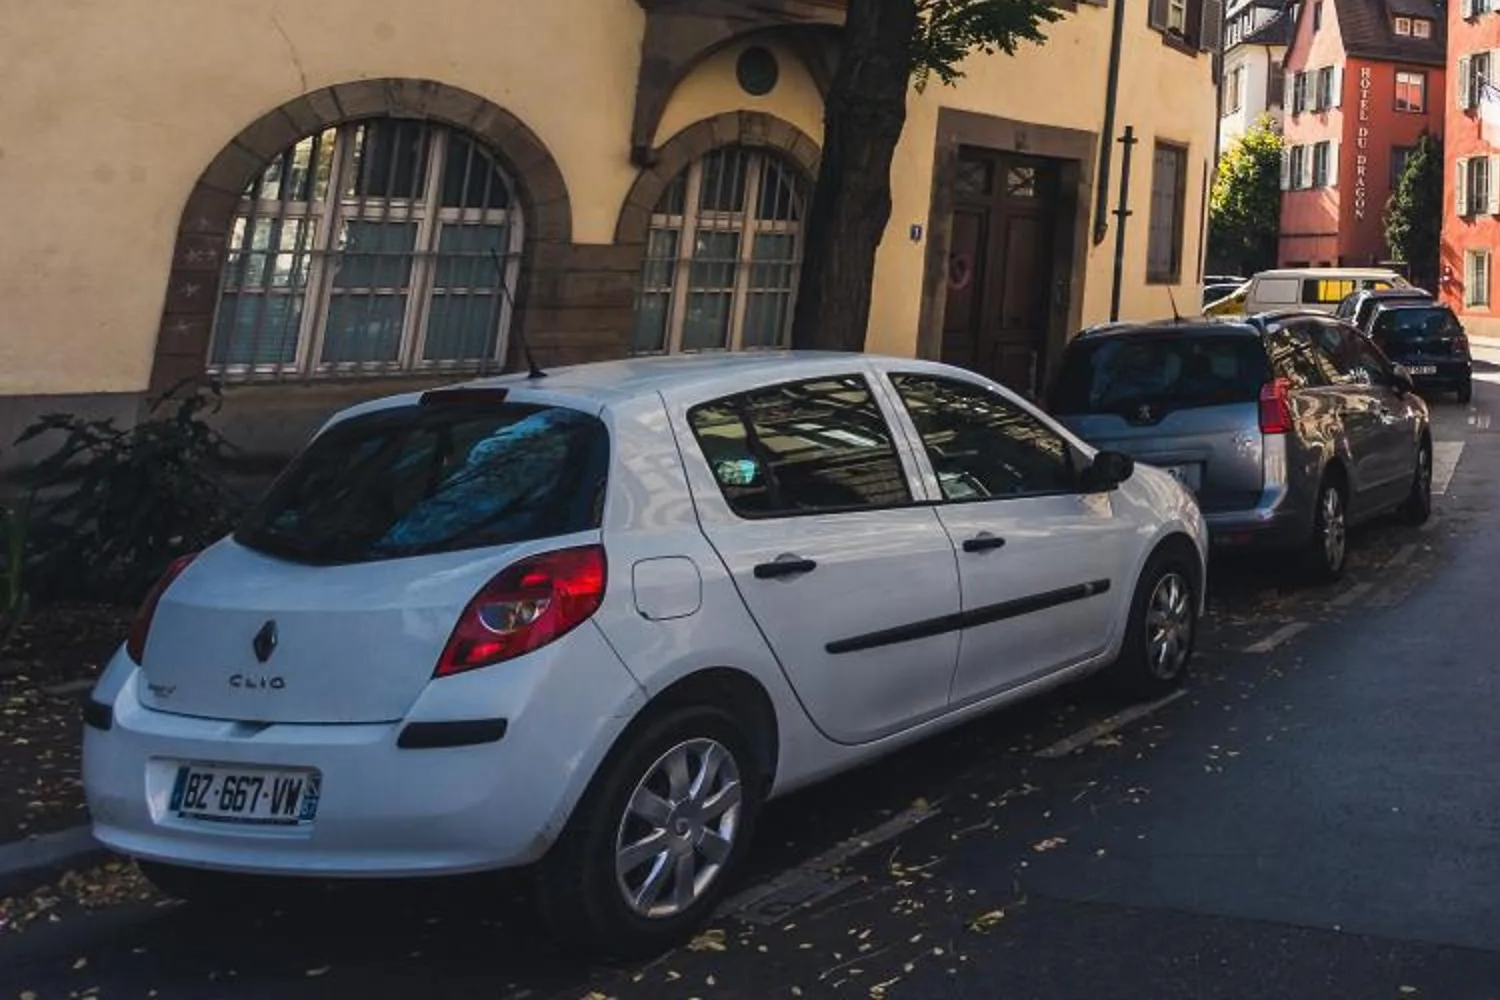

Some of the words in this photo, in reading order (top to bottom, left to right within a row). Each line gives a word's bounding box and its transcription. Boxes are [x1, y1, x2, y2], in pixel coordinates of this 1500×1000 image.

[1360, 67, 1371, 121] HOTEL
[1358, 127, 1368, 149] DU
[1356, 155, 1367, 219] DRAGON
[228, 673, 286, 690] CLIO
